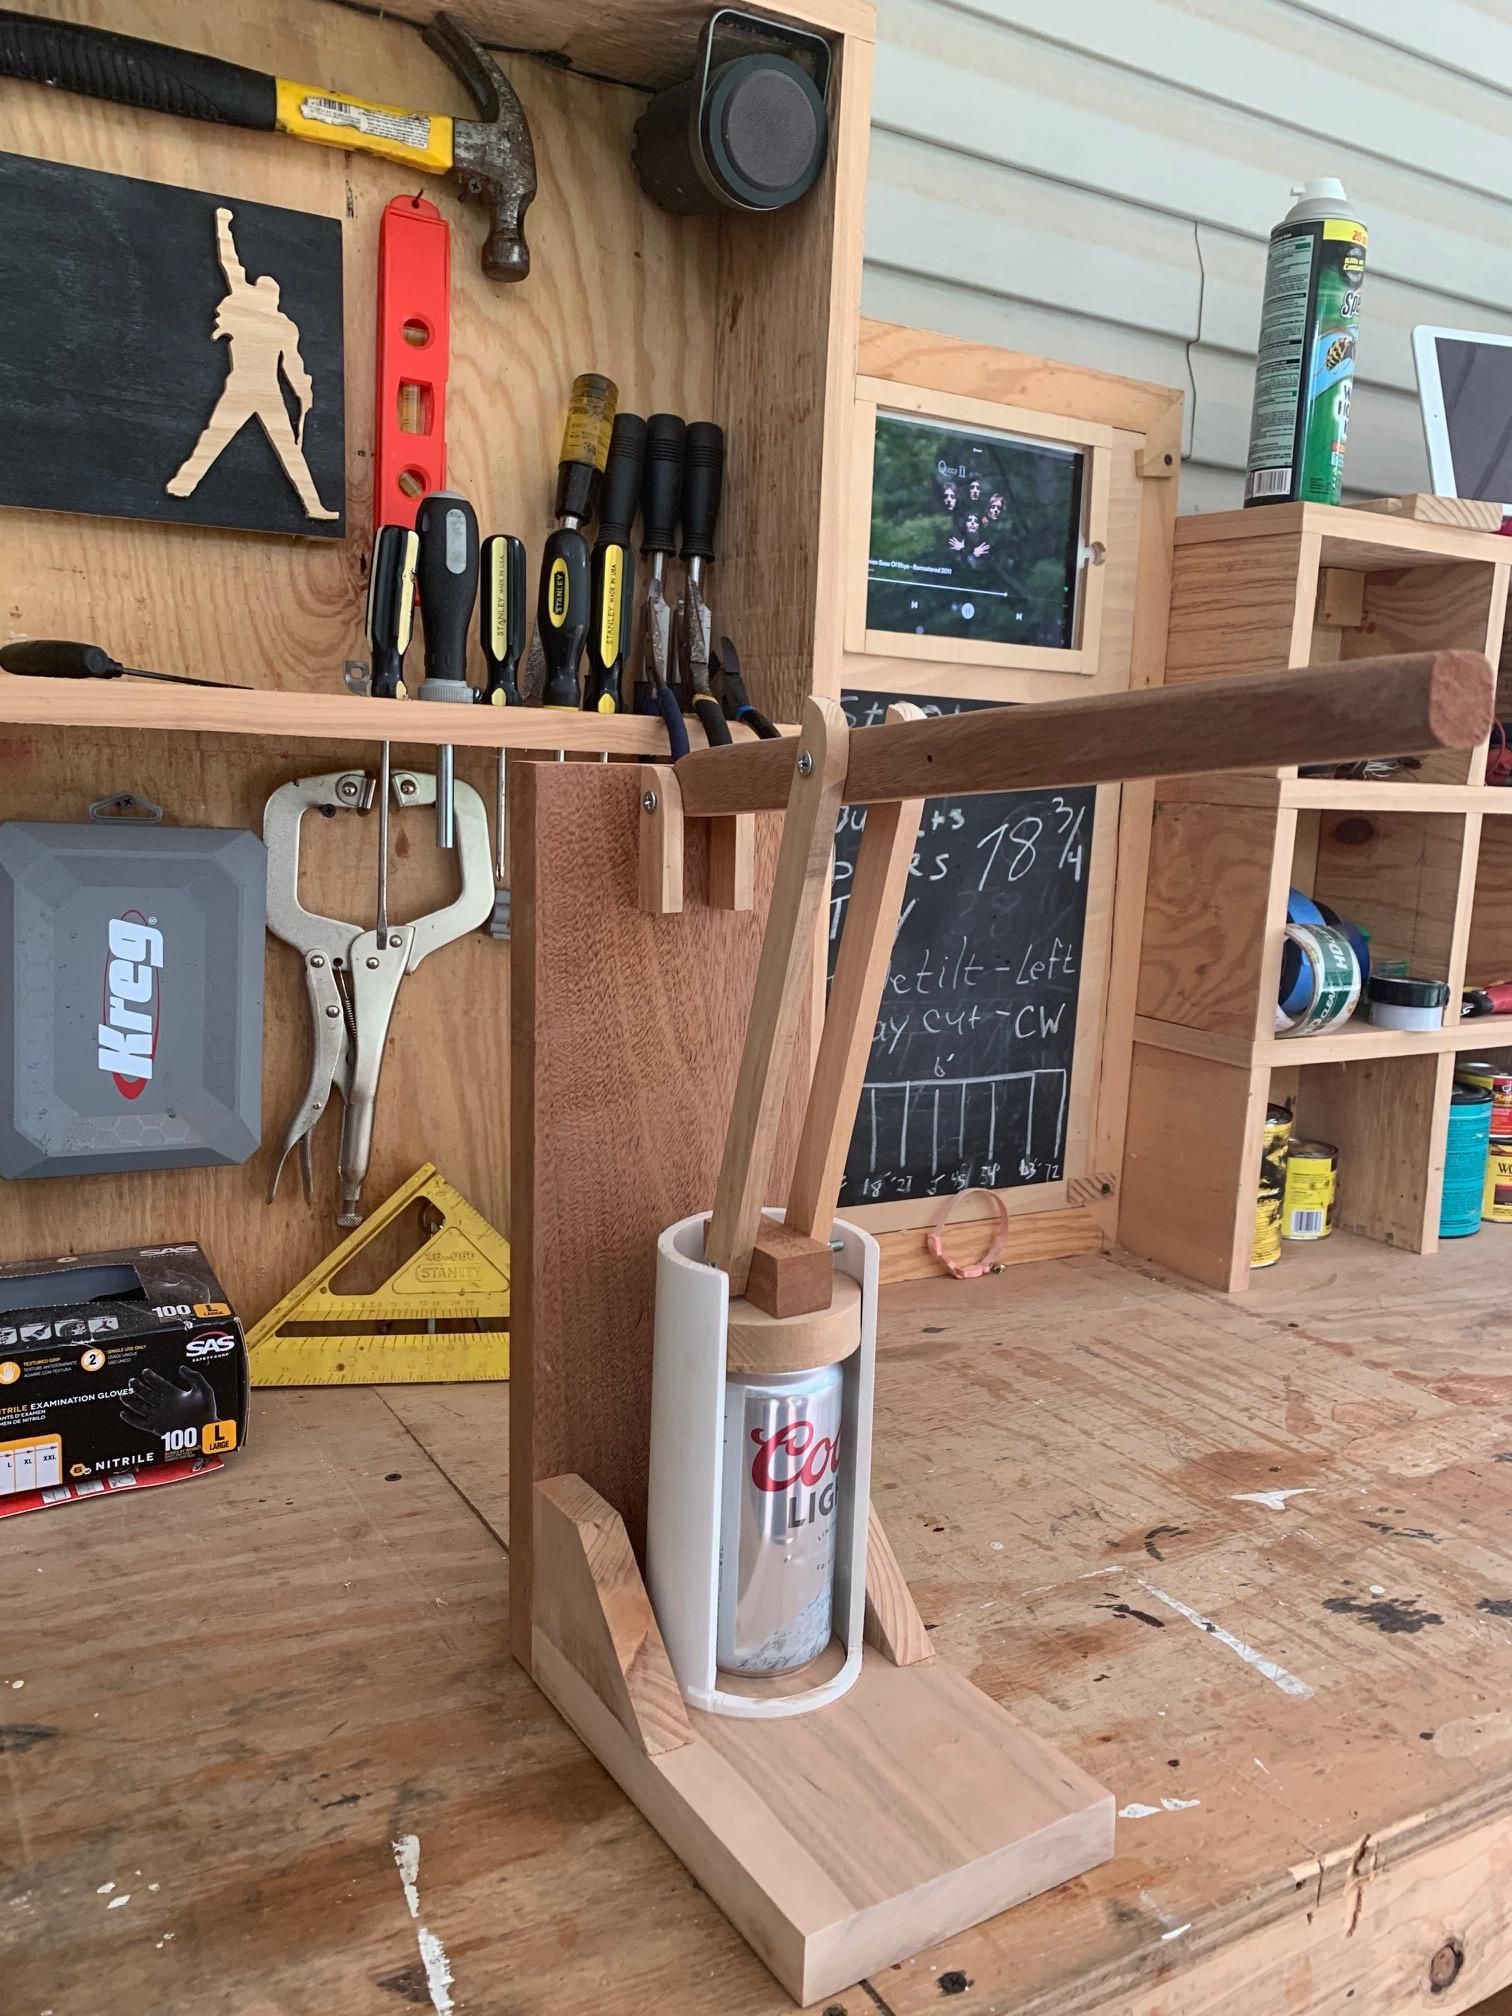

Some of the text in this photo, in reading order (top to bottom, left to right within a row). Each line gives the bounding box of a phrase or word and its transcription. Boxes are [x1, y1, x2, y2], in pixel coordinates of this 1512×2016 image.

[554, 573, 564, 615] STANLEY
[497, 598, 505, 636] STANLEY
[606, 607, 615, 645] STANLEY
[98, 918, 164, 1080] Kreg
[1015, 1003, 1066, 1039] CW
[139, 1245, 199, 1257] SAS
[152, 1304, 191, 1317] 100
[186, 1336, 235, 1357] SAS
[89, 1354, 97, 1365] 2
[0, 1387, 134, 1416] ITRILE EXAMINATION GLOVES
[161, 1425, 225, 1452] 100 L
[209, 1441, 229, 1451] LARGE
[43, 1454, 57, 1462] XXL
[95, 1452, 155, 1471] NITRILE
